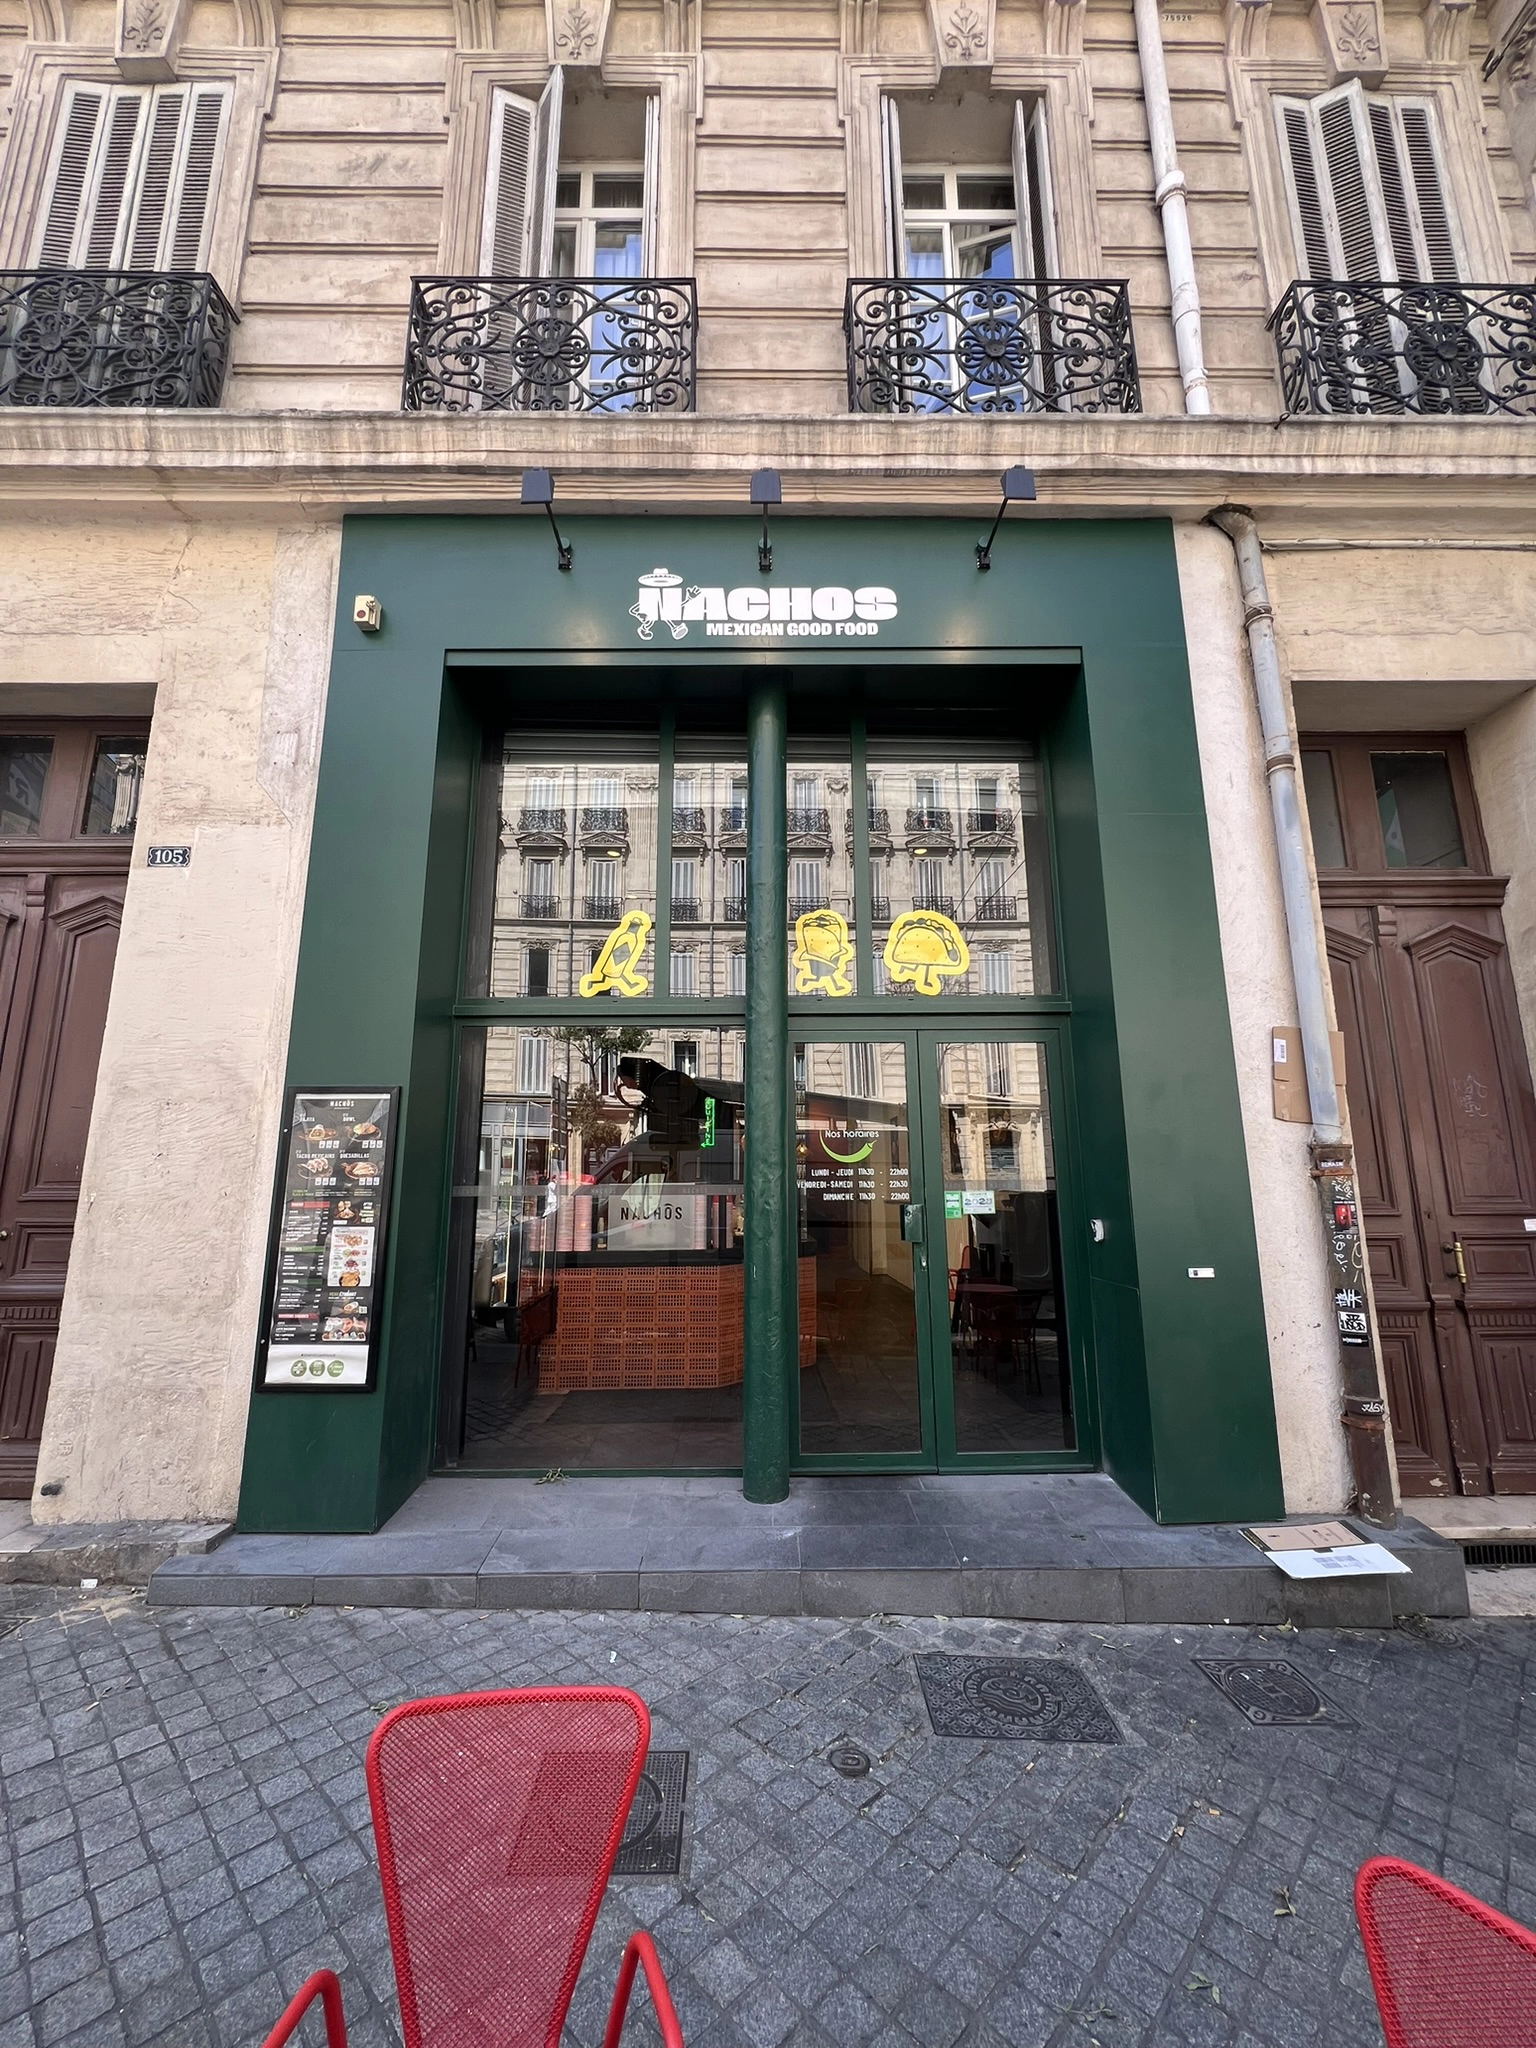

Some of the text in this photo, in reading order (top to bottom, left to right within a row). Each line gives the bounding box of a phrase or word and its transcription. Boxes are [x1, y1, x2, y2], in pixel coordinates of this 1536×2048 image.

[638, 586, 898, 621] NACHOS
[706, 622, 878, 636] MEXICAN GOOD FOOD
[155, 849, 183, 864] 105
[825, 1129, 880, 1138] Nos horaires
[811, 1168, 829, 1176] LUNDI
[836, 1168, 854, 1176] JEUDI
[889, 1168, 909, 1176] 22h00
[823, 1193, 854, 1201] DIMANCHE
[890, 1192, 910, 1200] 22h00
